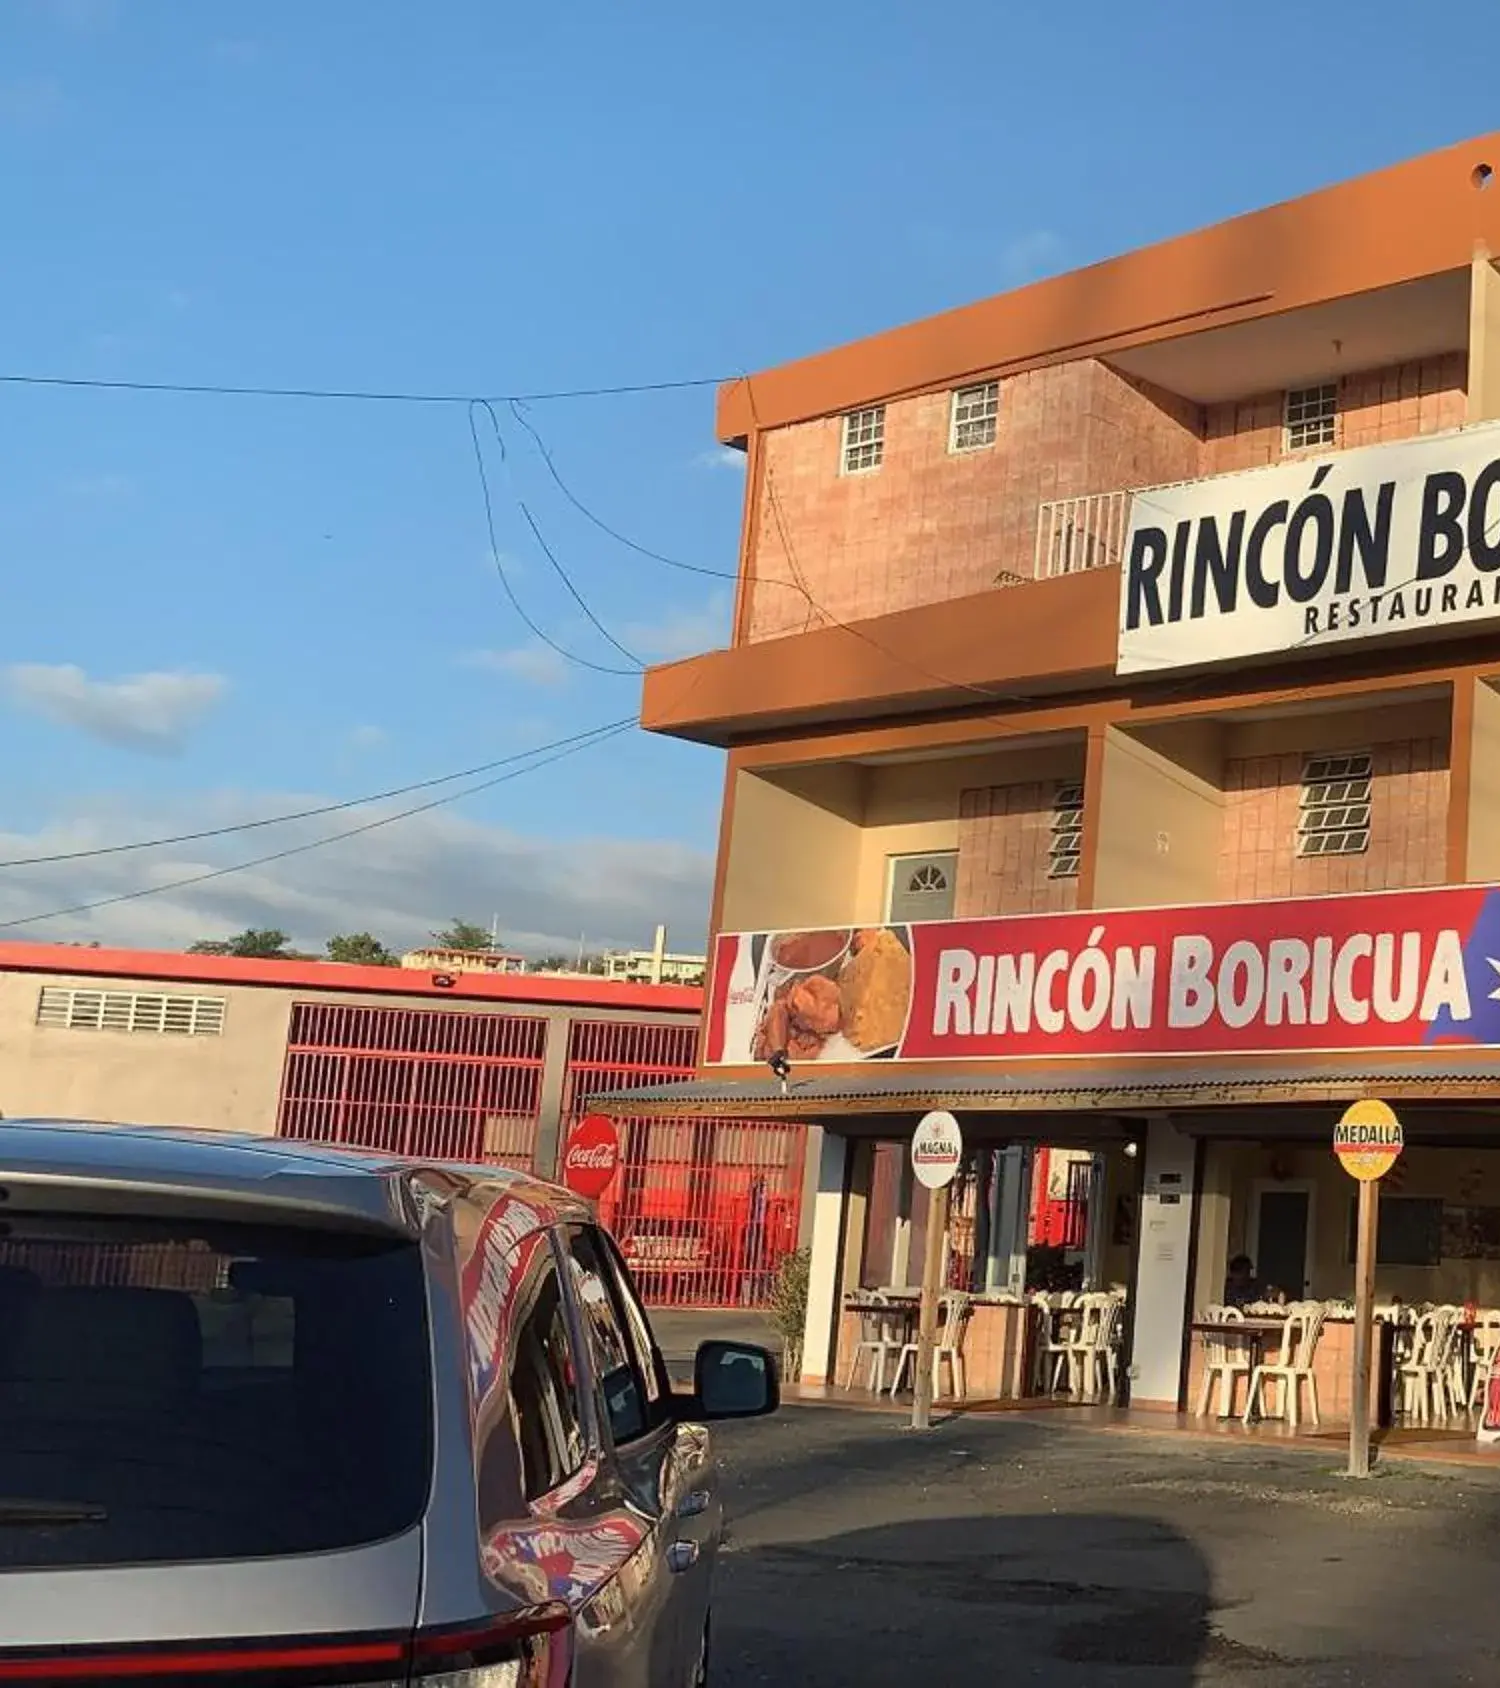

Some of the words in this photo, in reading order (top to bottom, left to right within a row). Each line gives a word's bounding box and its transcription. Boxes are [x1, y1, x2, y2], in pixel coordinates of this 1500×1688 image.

[1126, 465, 1396, 630] RINCÓN
[932, 925, 1157, 1037] RINCÓN
[1167, 929, 1472, 1030] BORICUA
[1335, 1125, 1401, 1144] MEDALLA
[565, 1143, 616, 1169] Coca-Cola
[920, 1141, 953, 1155] MAGNA
